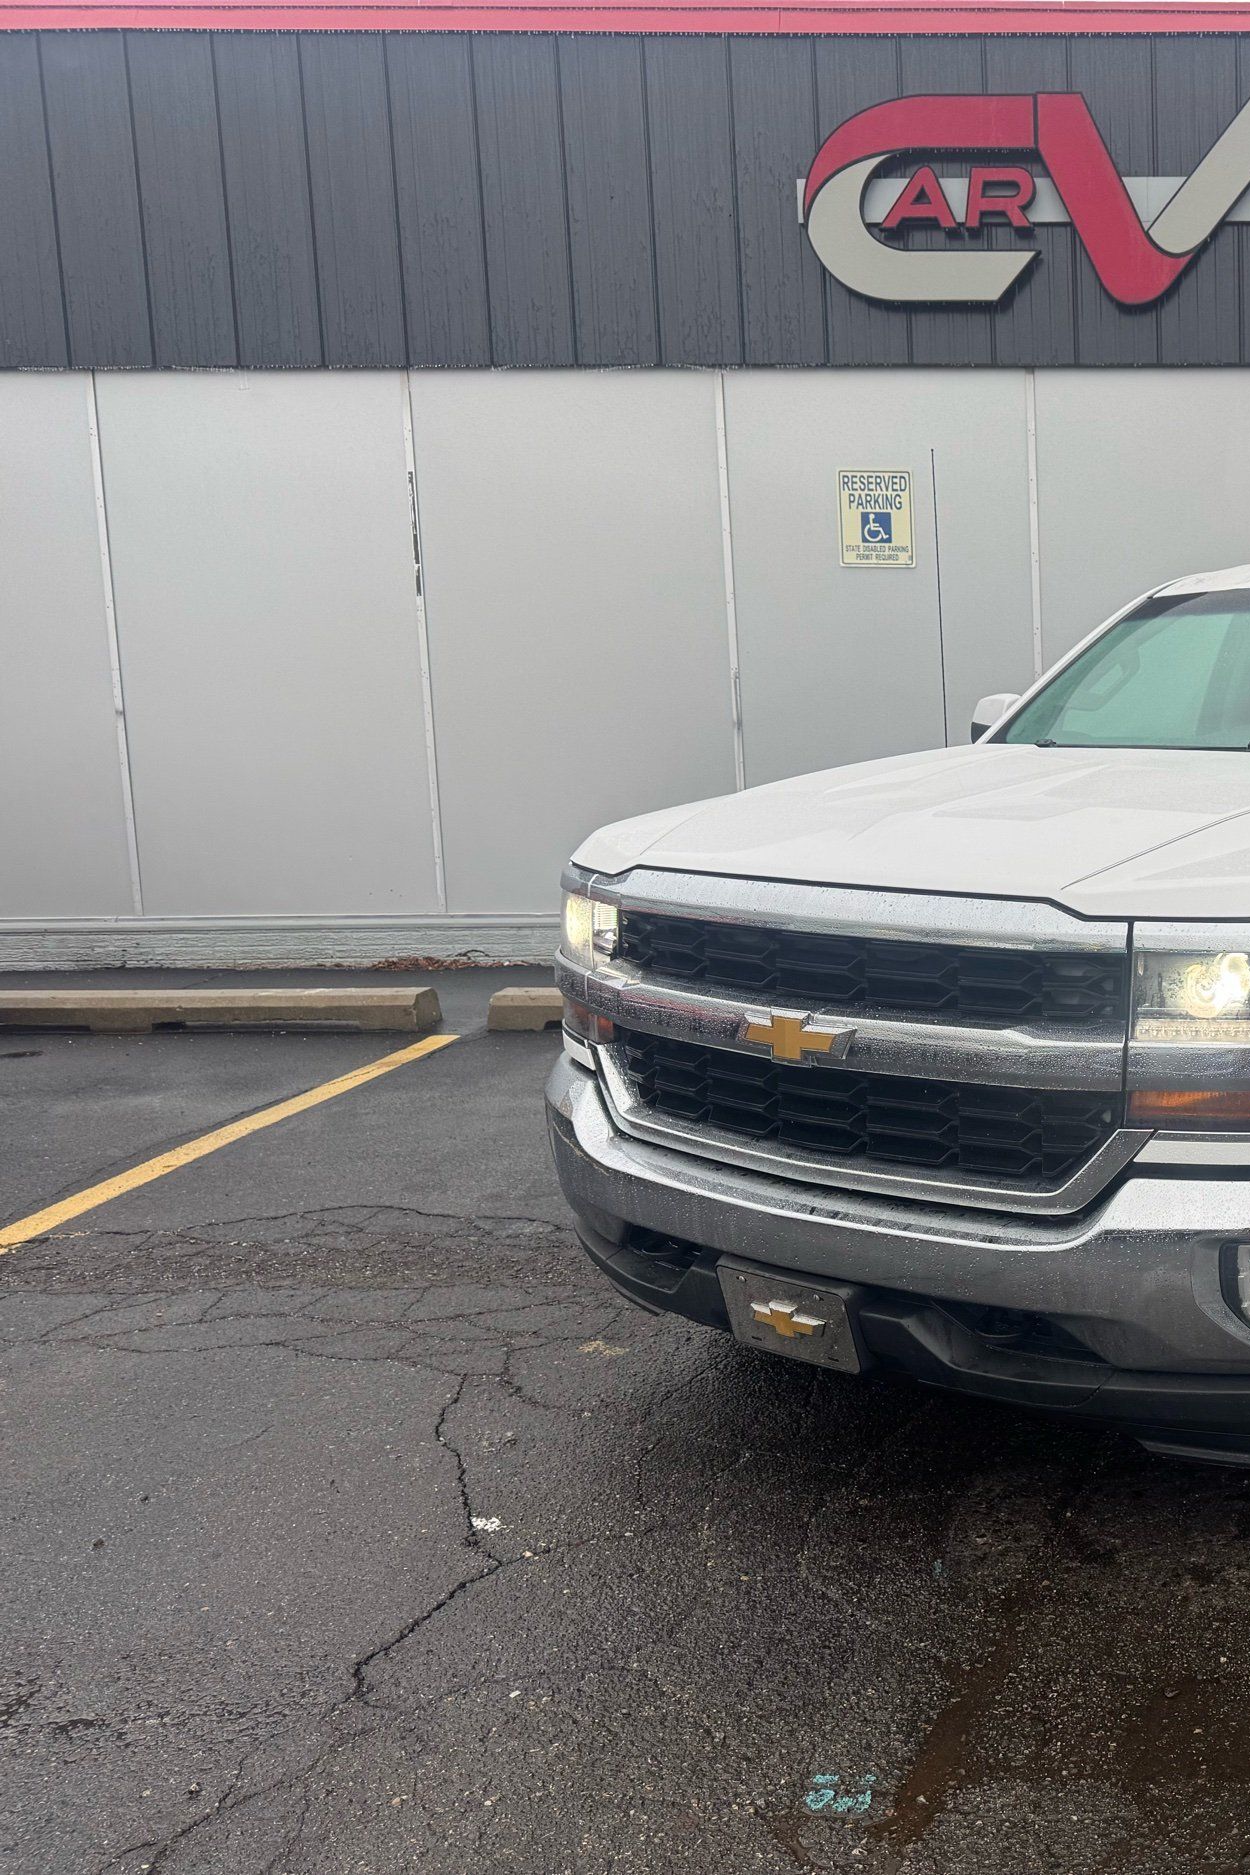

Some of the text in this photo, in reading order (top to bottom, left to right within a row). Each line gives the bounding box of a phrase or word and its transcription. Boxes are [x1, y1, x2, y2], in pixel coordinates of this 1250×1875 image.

[842, 474, 908, 492] RESERVED
[848, 493, 903, 510] PARKING
[845, 544, 861, 552] STATE
[863, 545, 886, 553] DISABLED
